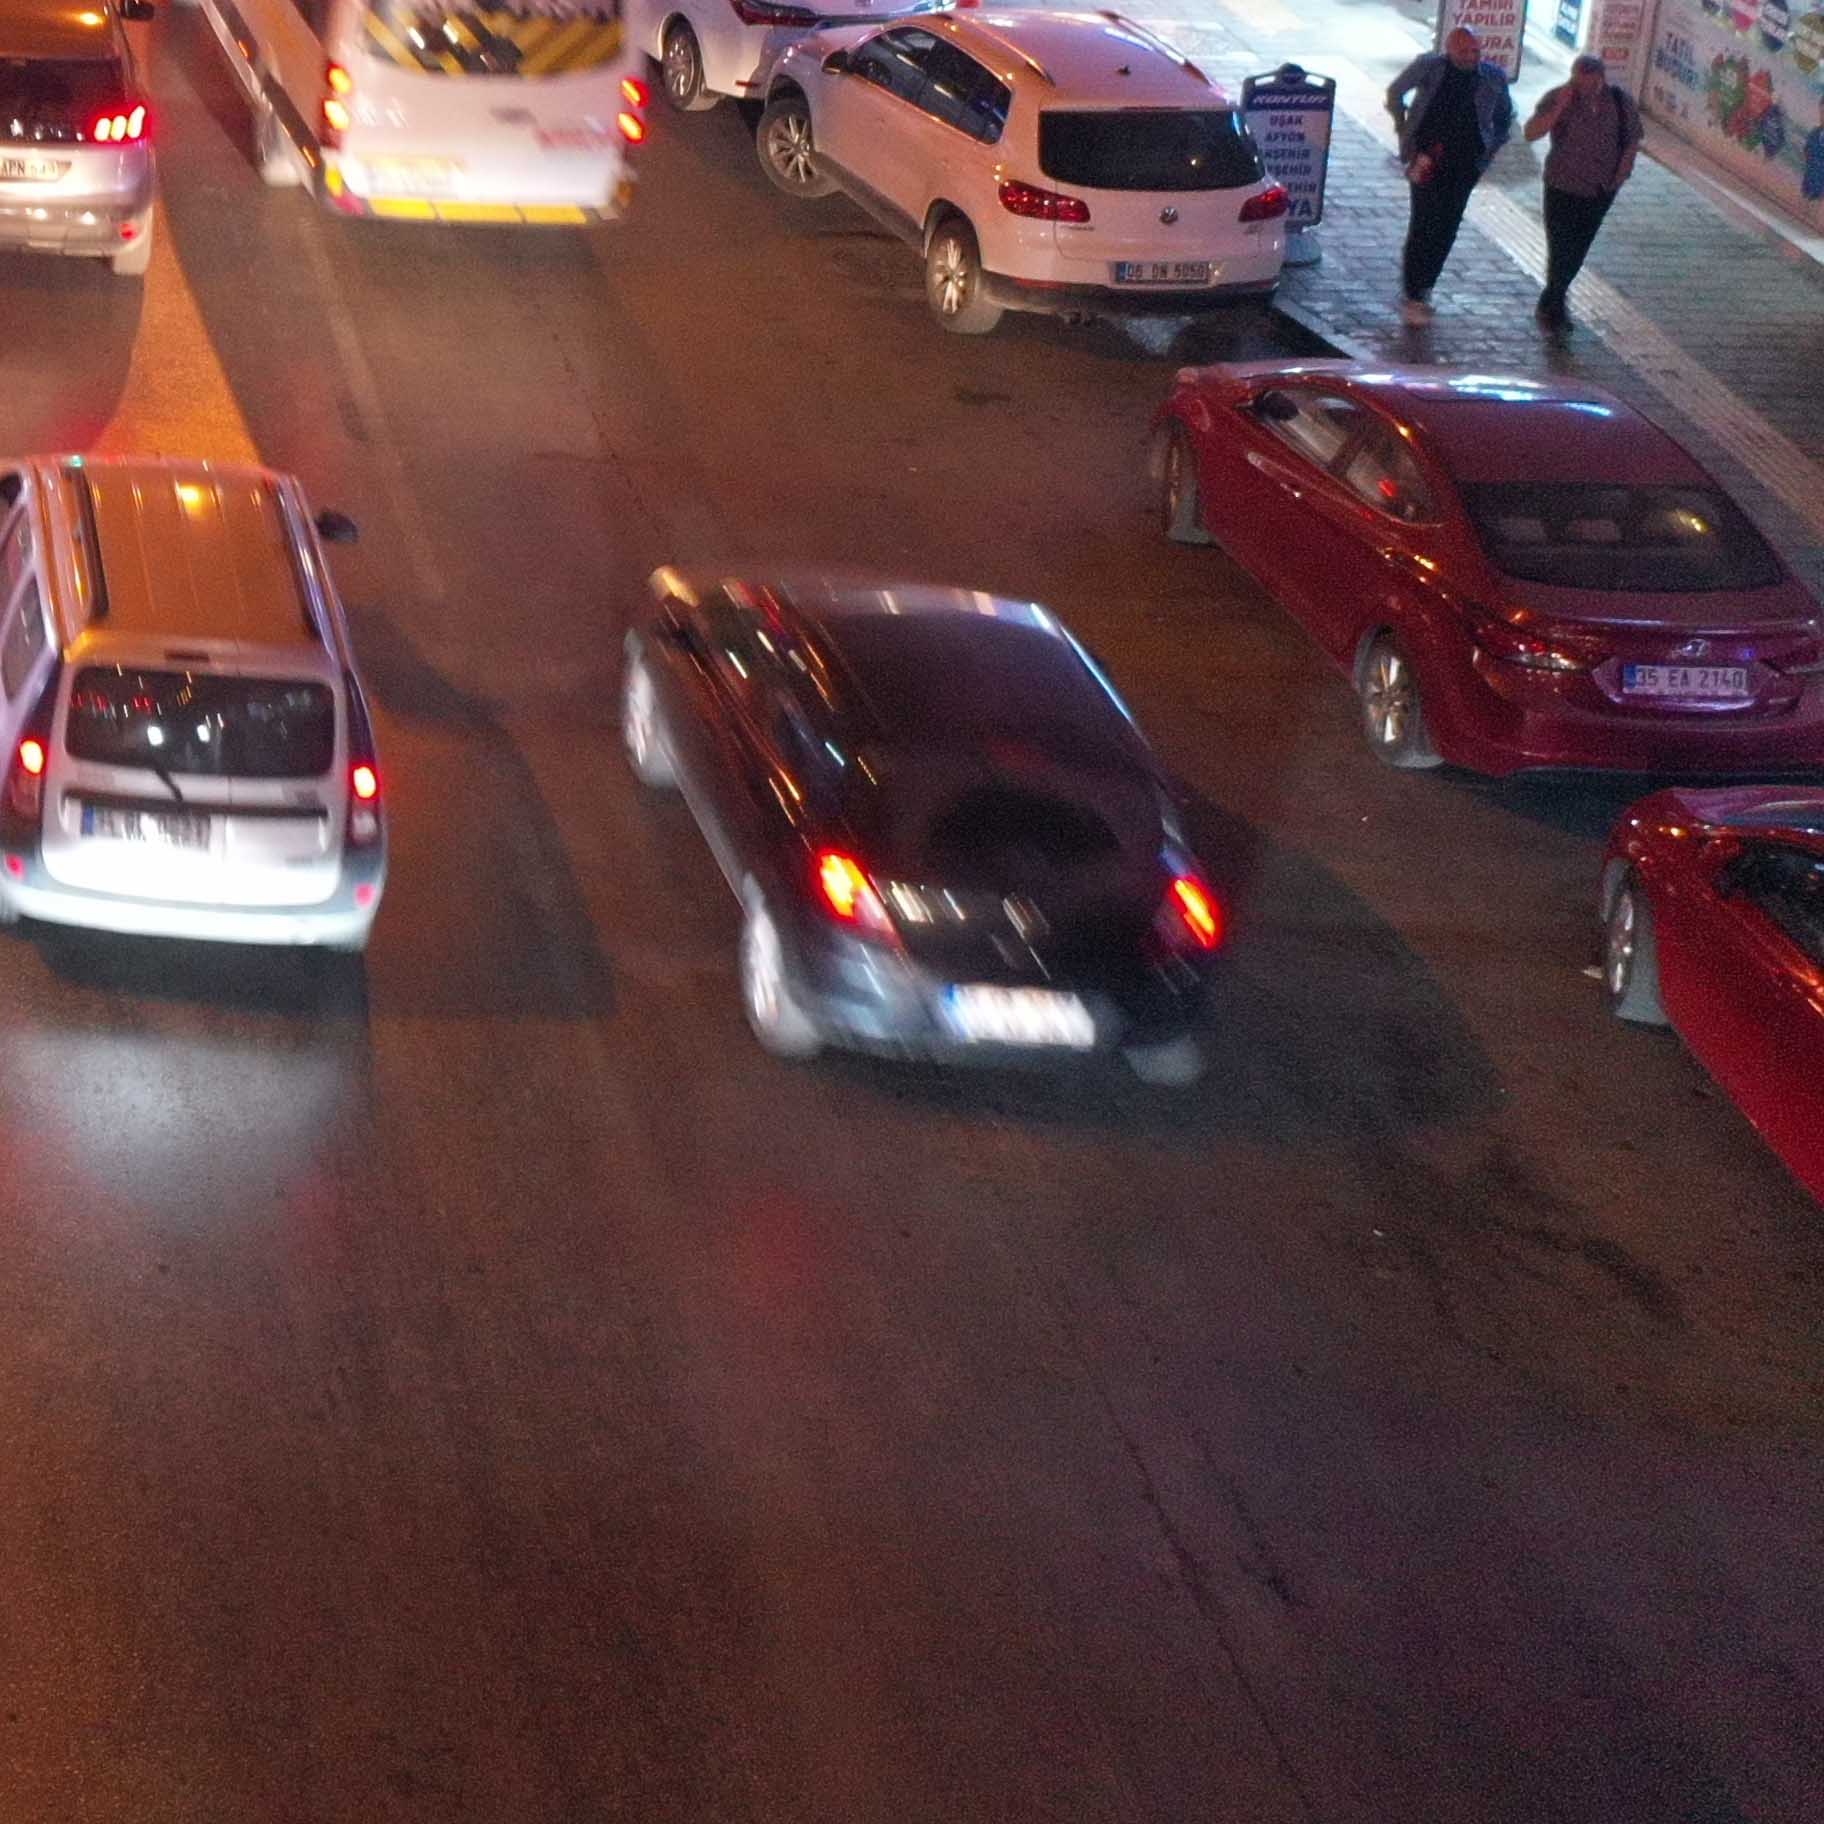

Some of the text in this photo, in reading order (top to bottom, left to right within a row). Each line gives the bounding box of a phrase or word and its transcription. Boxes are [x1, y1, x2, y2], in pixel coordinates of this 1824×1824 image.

[1269, 114, 1303, 128] UŞAK
[1265, 131, 1306, 143] AFYON
[1637, 668, 1658, 686] 35
[1667, 669, 1690, 688] EA
